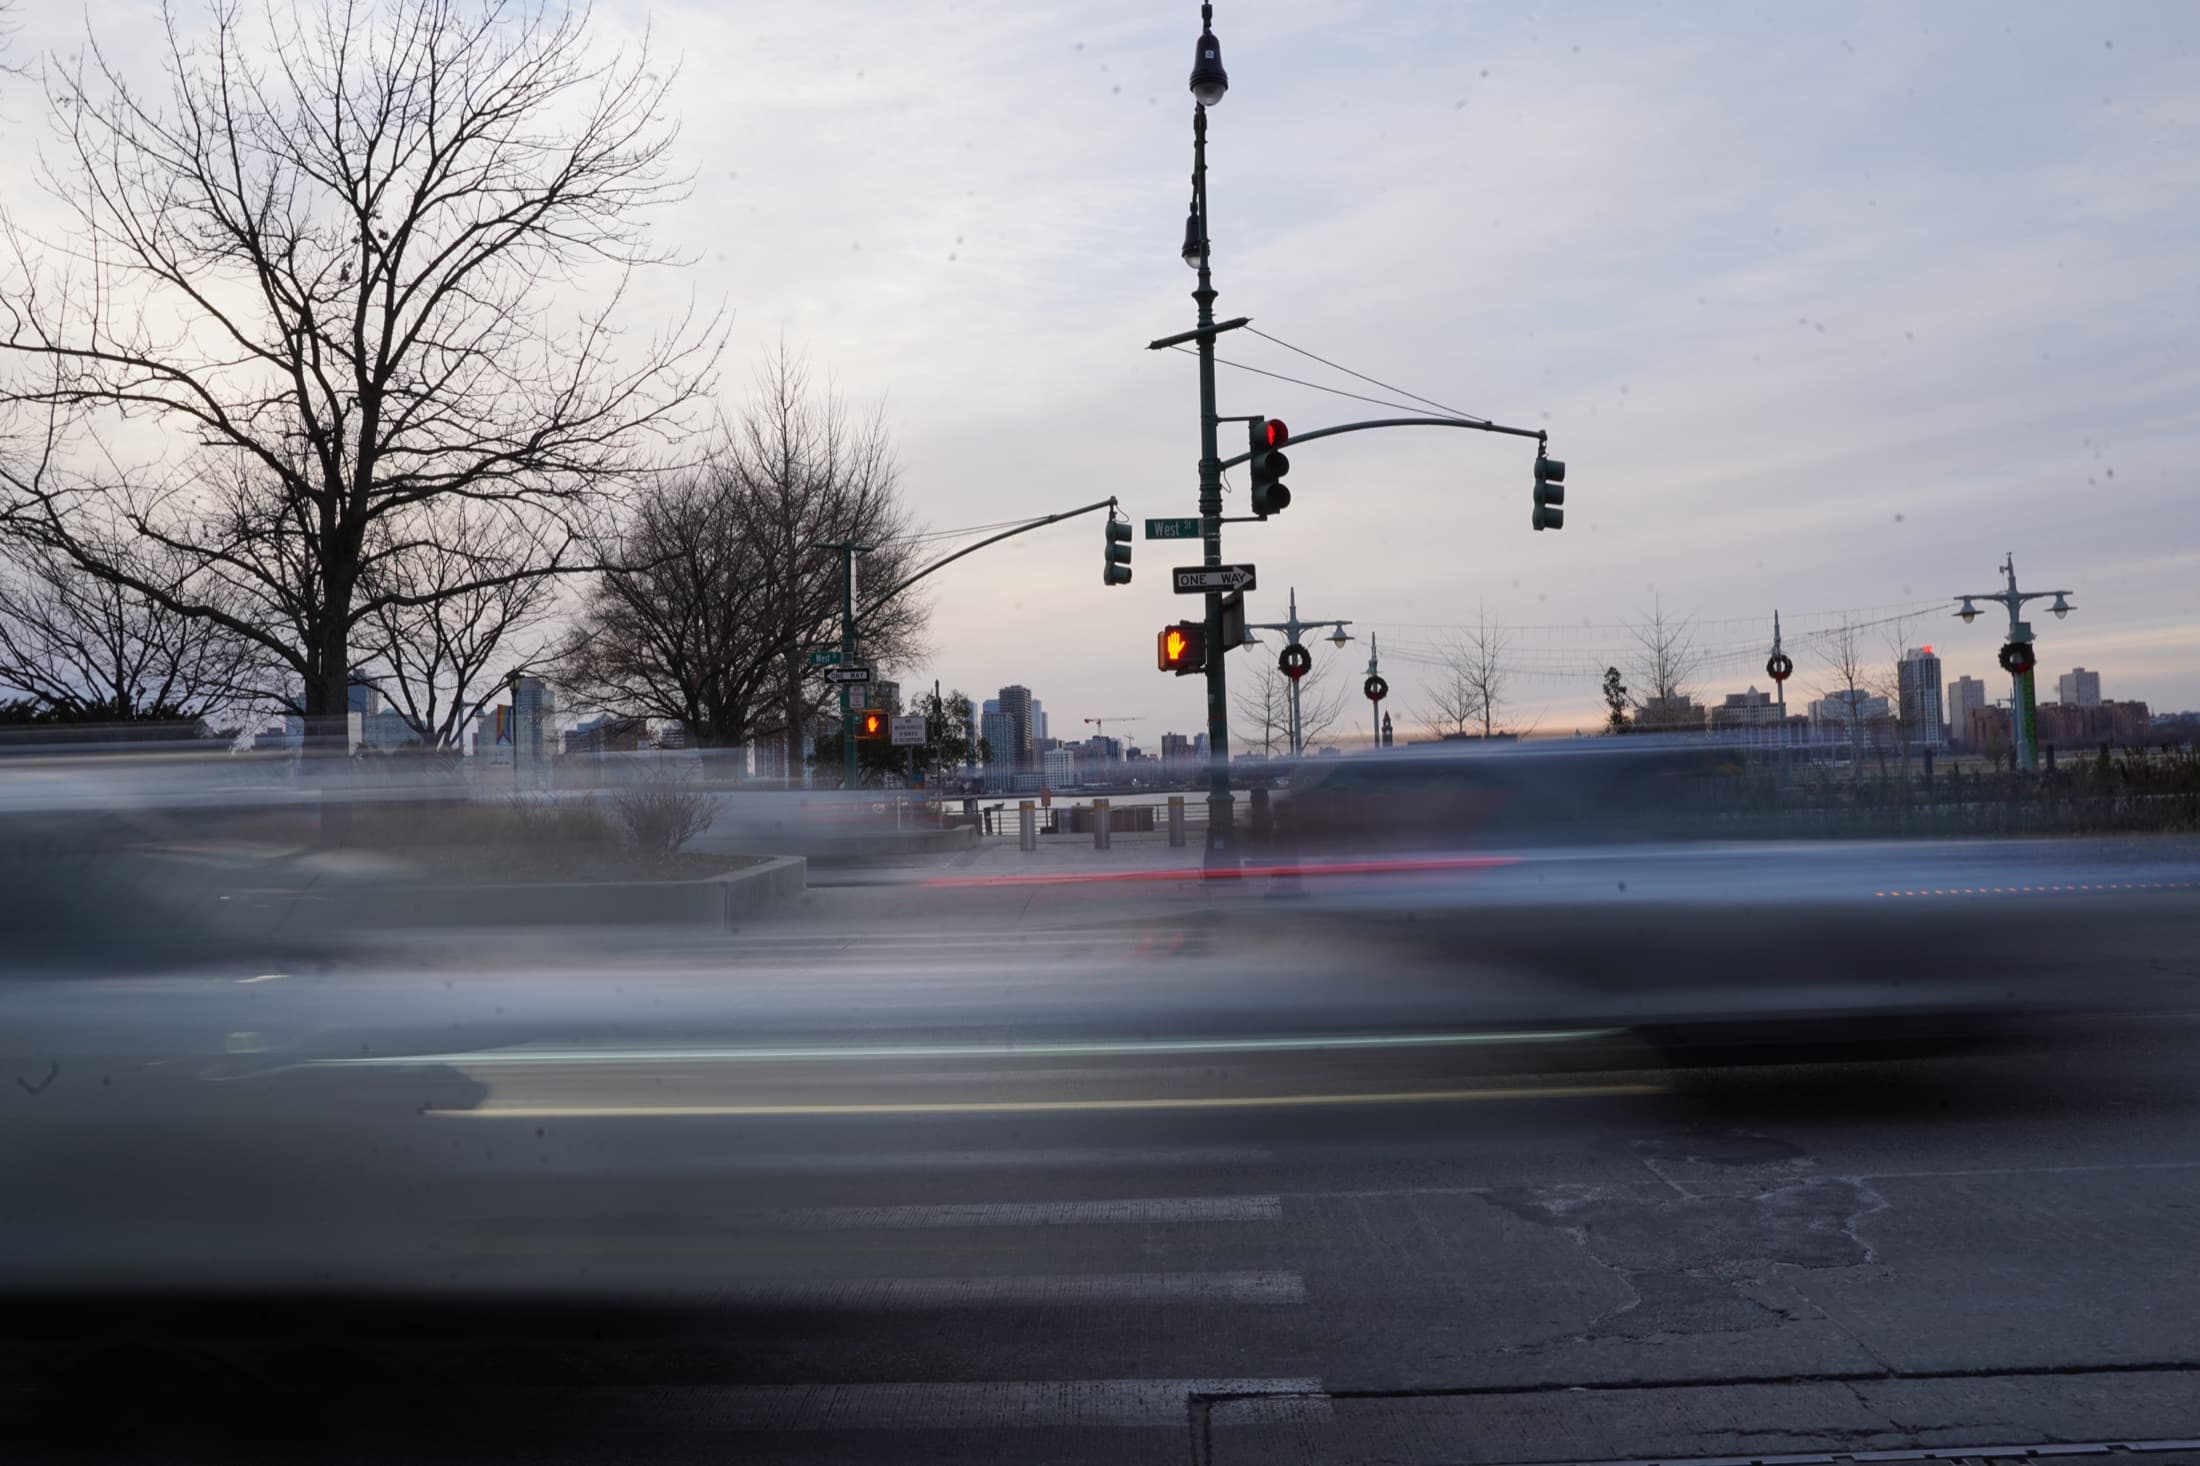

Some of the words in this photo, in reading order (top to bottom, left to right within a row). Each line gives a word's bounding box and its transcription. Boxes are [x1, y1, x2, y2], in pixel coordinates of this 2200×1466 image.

[1154, 521, 1180, 537] West
[1181, 574, 1208, 586] ONE
[1221, 572, 1246, 585] WAY
